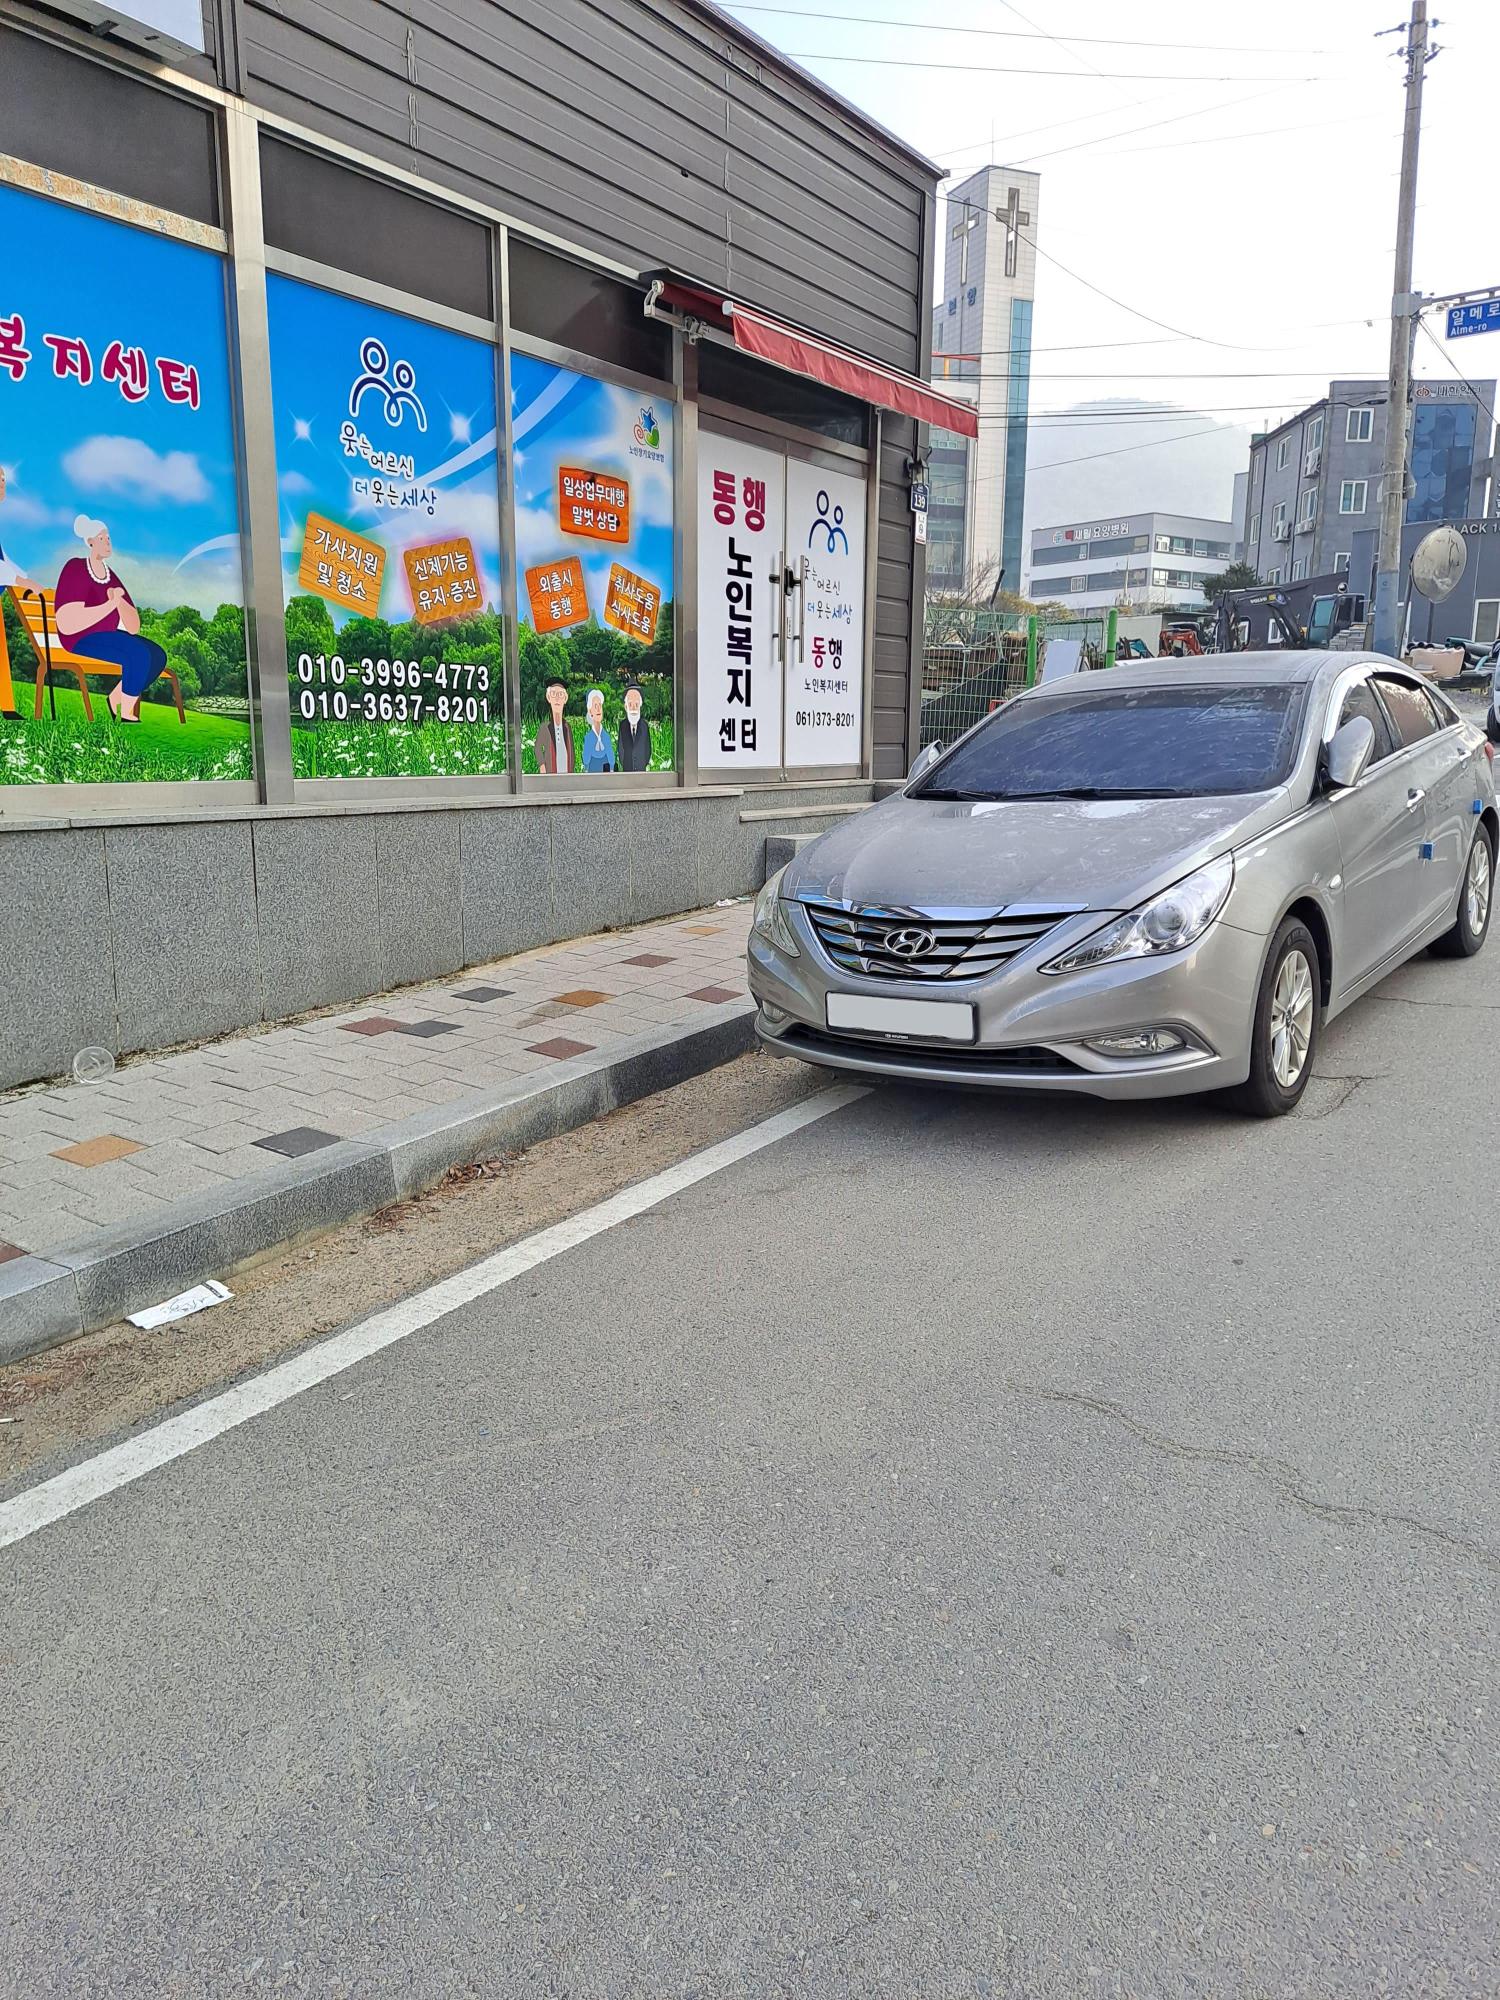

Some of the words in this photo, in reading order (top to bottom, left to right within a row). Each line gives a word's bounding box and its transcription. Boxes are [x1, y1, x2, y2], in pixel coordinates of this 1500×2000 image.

[1450, 322, 1488, 336] Alme-ro
[1451, 302, 1500, 326] 알메로
[563, 476, 625, 508] 일상업무대행
[712, 469, 766, 533] 동행
[914, 494, 926, 509] 139
[572, 505, 594, 528] 말벗
[597, 512, 619, 532] 상담
[315, 528, 378, 577] 가사지원
[414, 551, 468, 581] 신체기능
[317, 561, 333, 588] 및
[337, 569, 367, 601] 청소
[539, 568, 573, 593] 외출시
[613, 575, 655, 611] 취사도움
[550, 598, 573, 620] 동행
[611, 600, 651, 635] 식사도움
[811, 636, 843, 670] 동행
[297, 652, 489, 692] 010-3996-4773
[804, 678, 848, 694] 노인복지센터
[300, 689, 489, 724] 010-3637-8201
[796, 711, 855, 728] 061)373-8201
